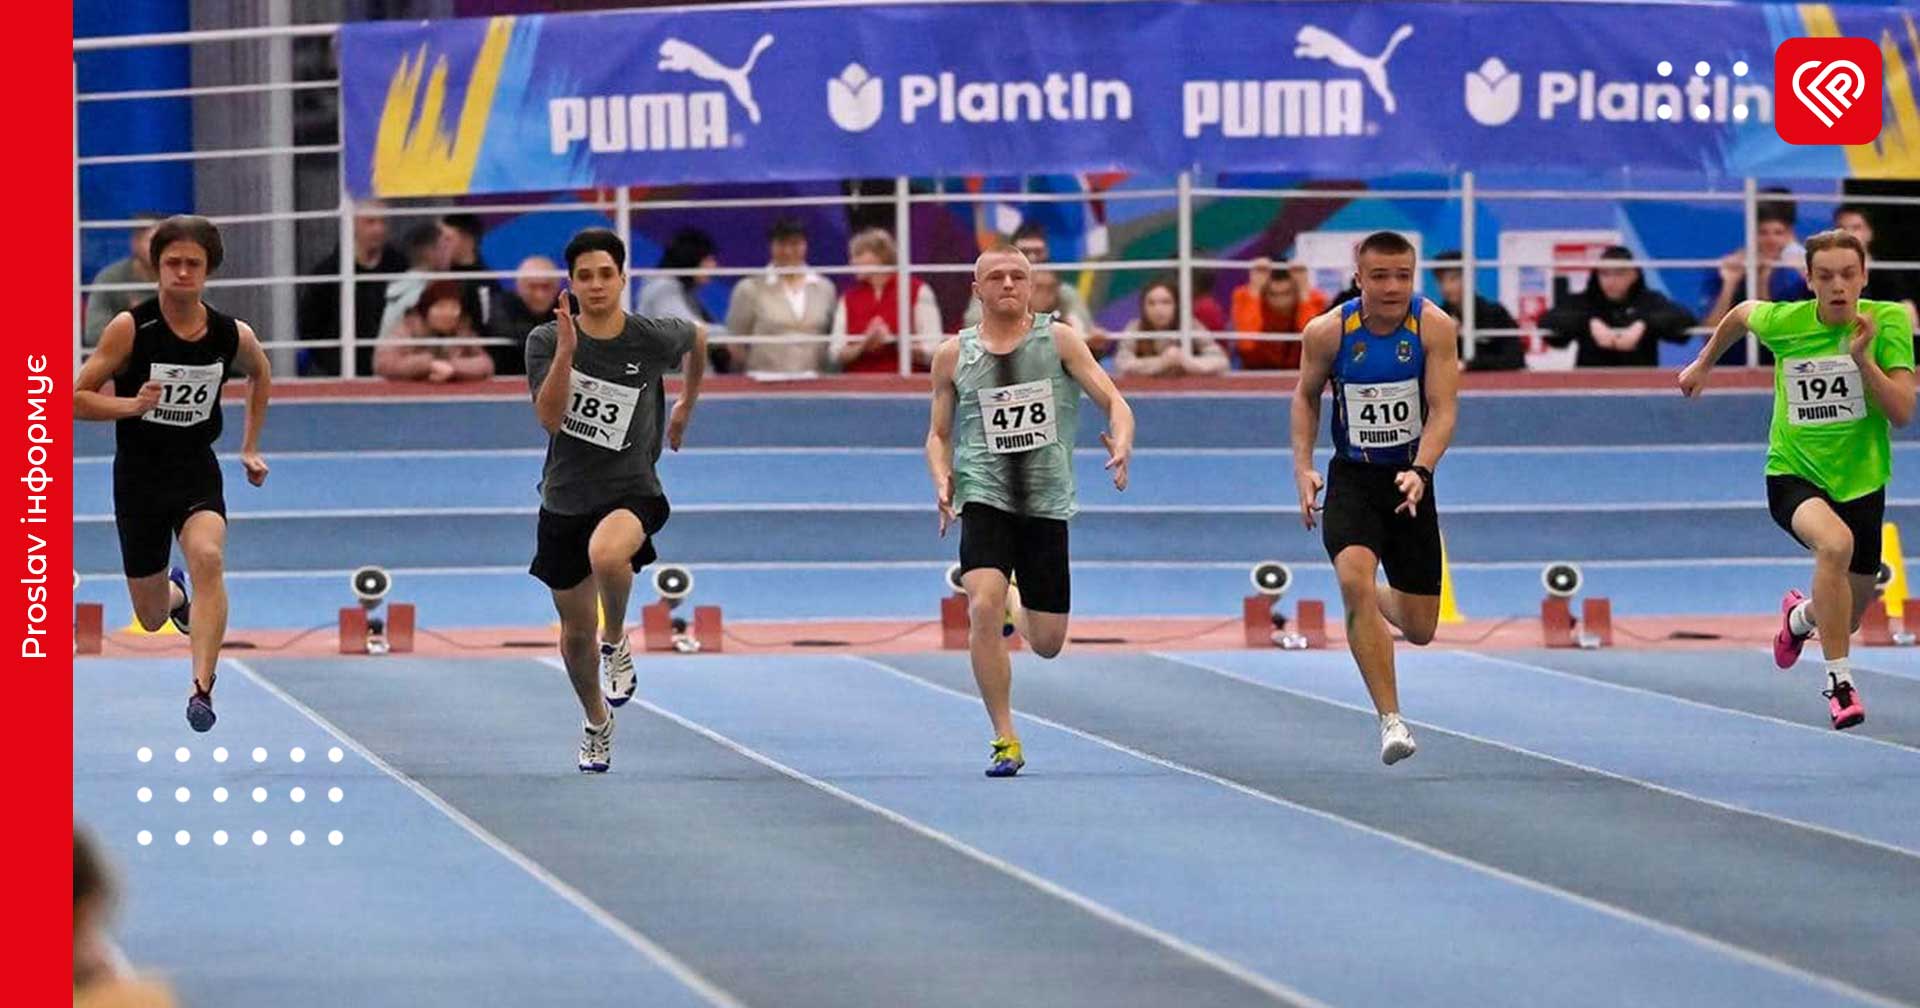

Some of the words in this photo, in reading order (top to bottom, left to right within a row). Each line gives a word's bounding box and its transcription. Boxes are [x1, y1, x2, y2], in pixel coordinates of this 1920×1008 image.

[1183, 79, 1365, 138] PUMA
[550, 92, 728, 154] PUMA
[164, 384, 208, 404] 126
[1797, 376, 1849, 401] 194
[153, 408, 193, 422] PUMA
[571, 392, 620, 424] 183
[992, 402, 1046, 429] 478
[1360, 401, 1409, 424] 410
[1797, 405, 1838, 420] PUMA
[995, 432, 1034, 449] PUMA
[1359, 430, 1398, 443] PUMA
